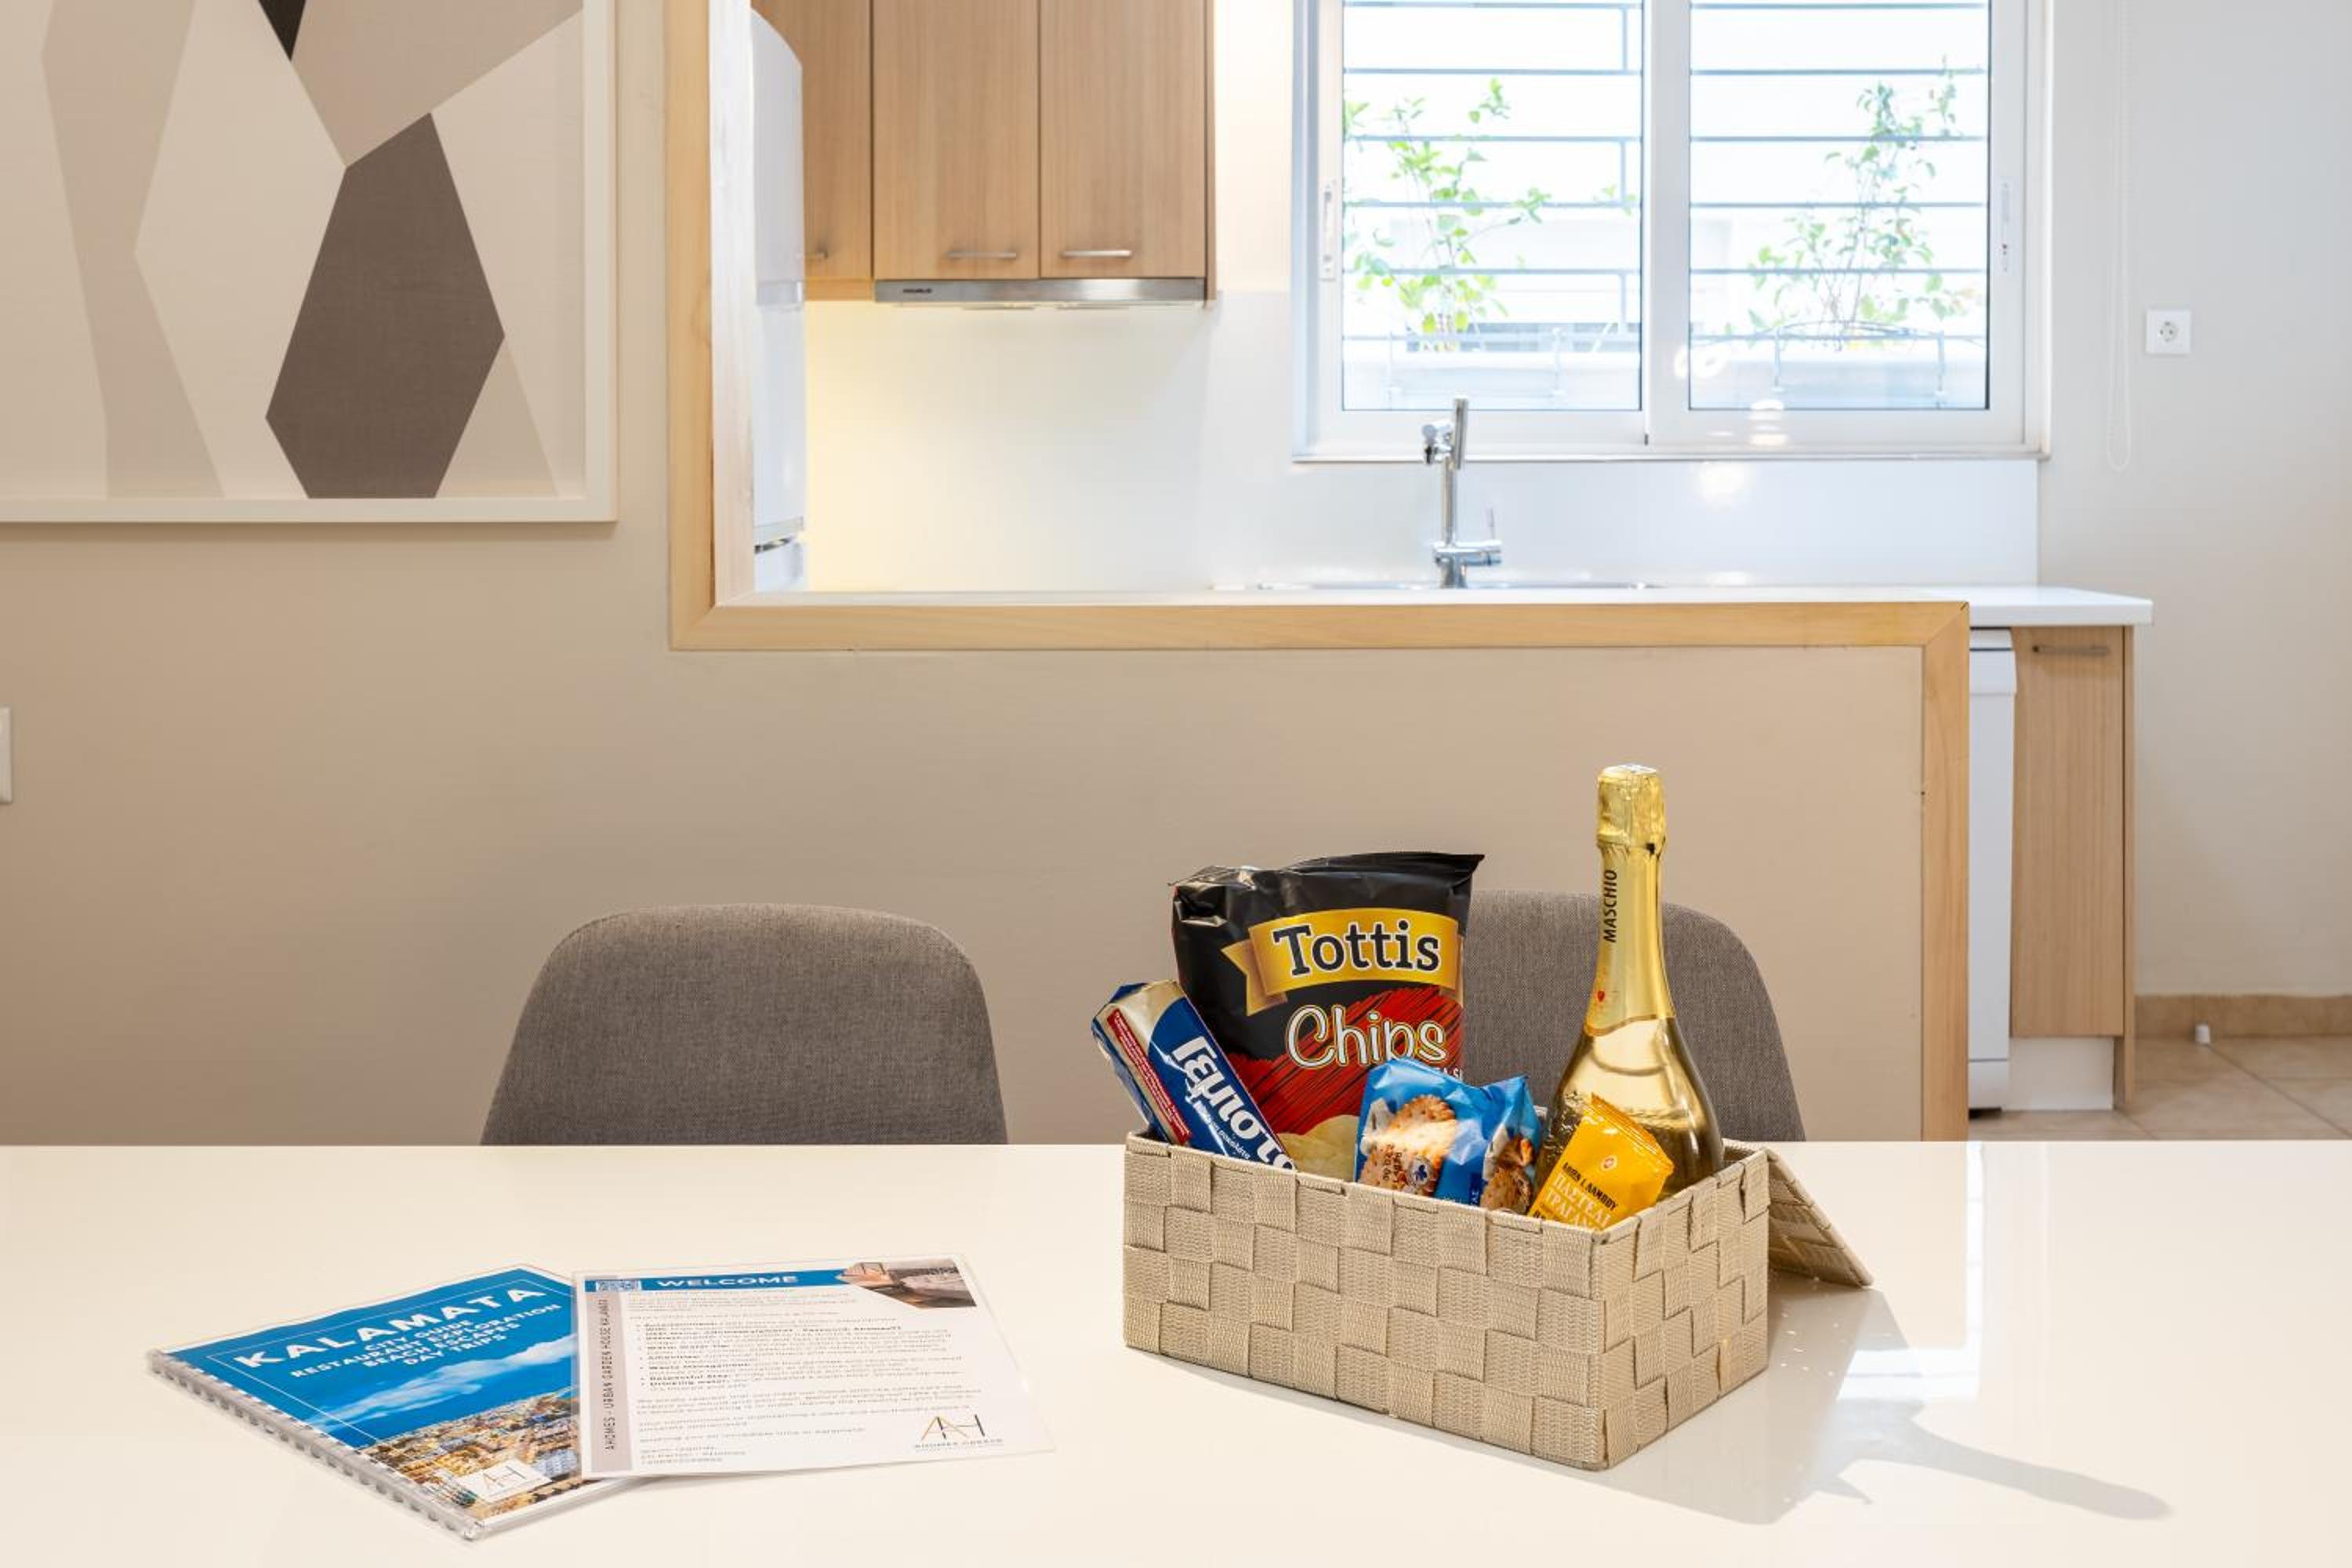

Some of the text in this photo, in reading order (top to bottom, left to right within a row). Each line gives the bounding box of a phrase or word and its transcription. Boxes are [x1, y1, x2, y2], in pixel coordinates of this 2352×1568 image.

[1603, 869, 1617, 943] MASCHIO
[1272, 919, 1441, 978] Tottis
[1287, 1004, 1449, 1069] Chips
[657, 1276, 799, 1287] WELCOME
[234, 1287, 546, 1369] KALAMATA
[289, 1303, 562, 1378] RESTAURANT EXPLORATION
[363, 1322, 523, 1368] BEACH ESCAPES
[365, 1319, 474, 1352] CITY GUIDE
[402, 1334, 508, 1366] DAY TRIPS
[602, 1381, 614, 1408] URBAN
[603, 1417, 615, 1450] AHOMES
